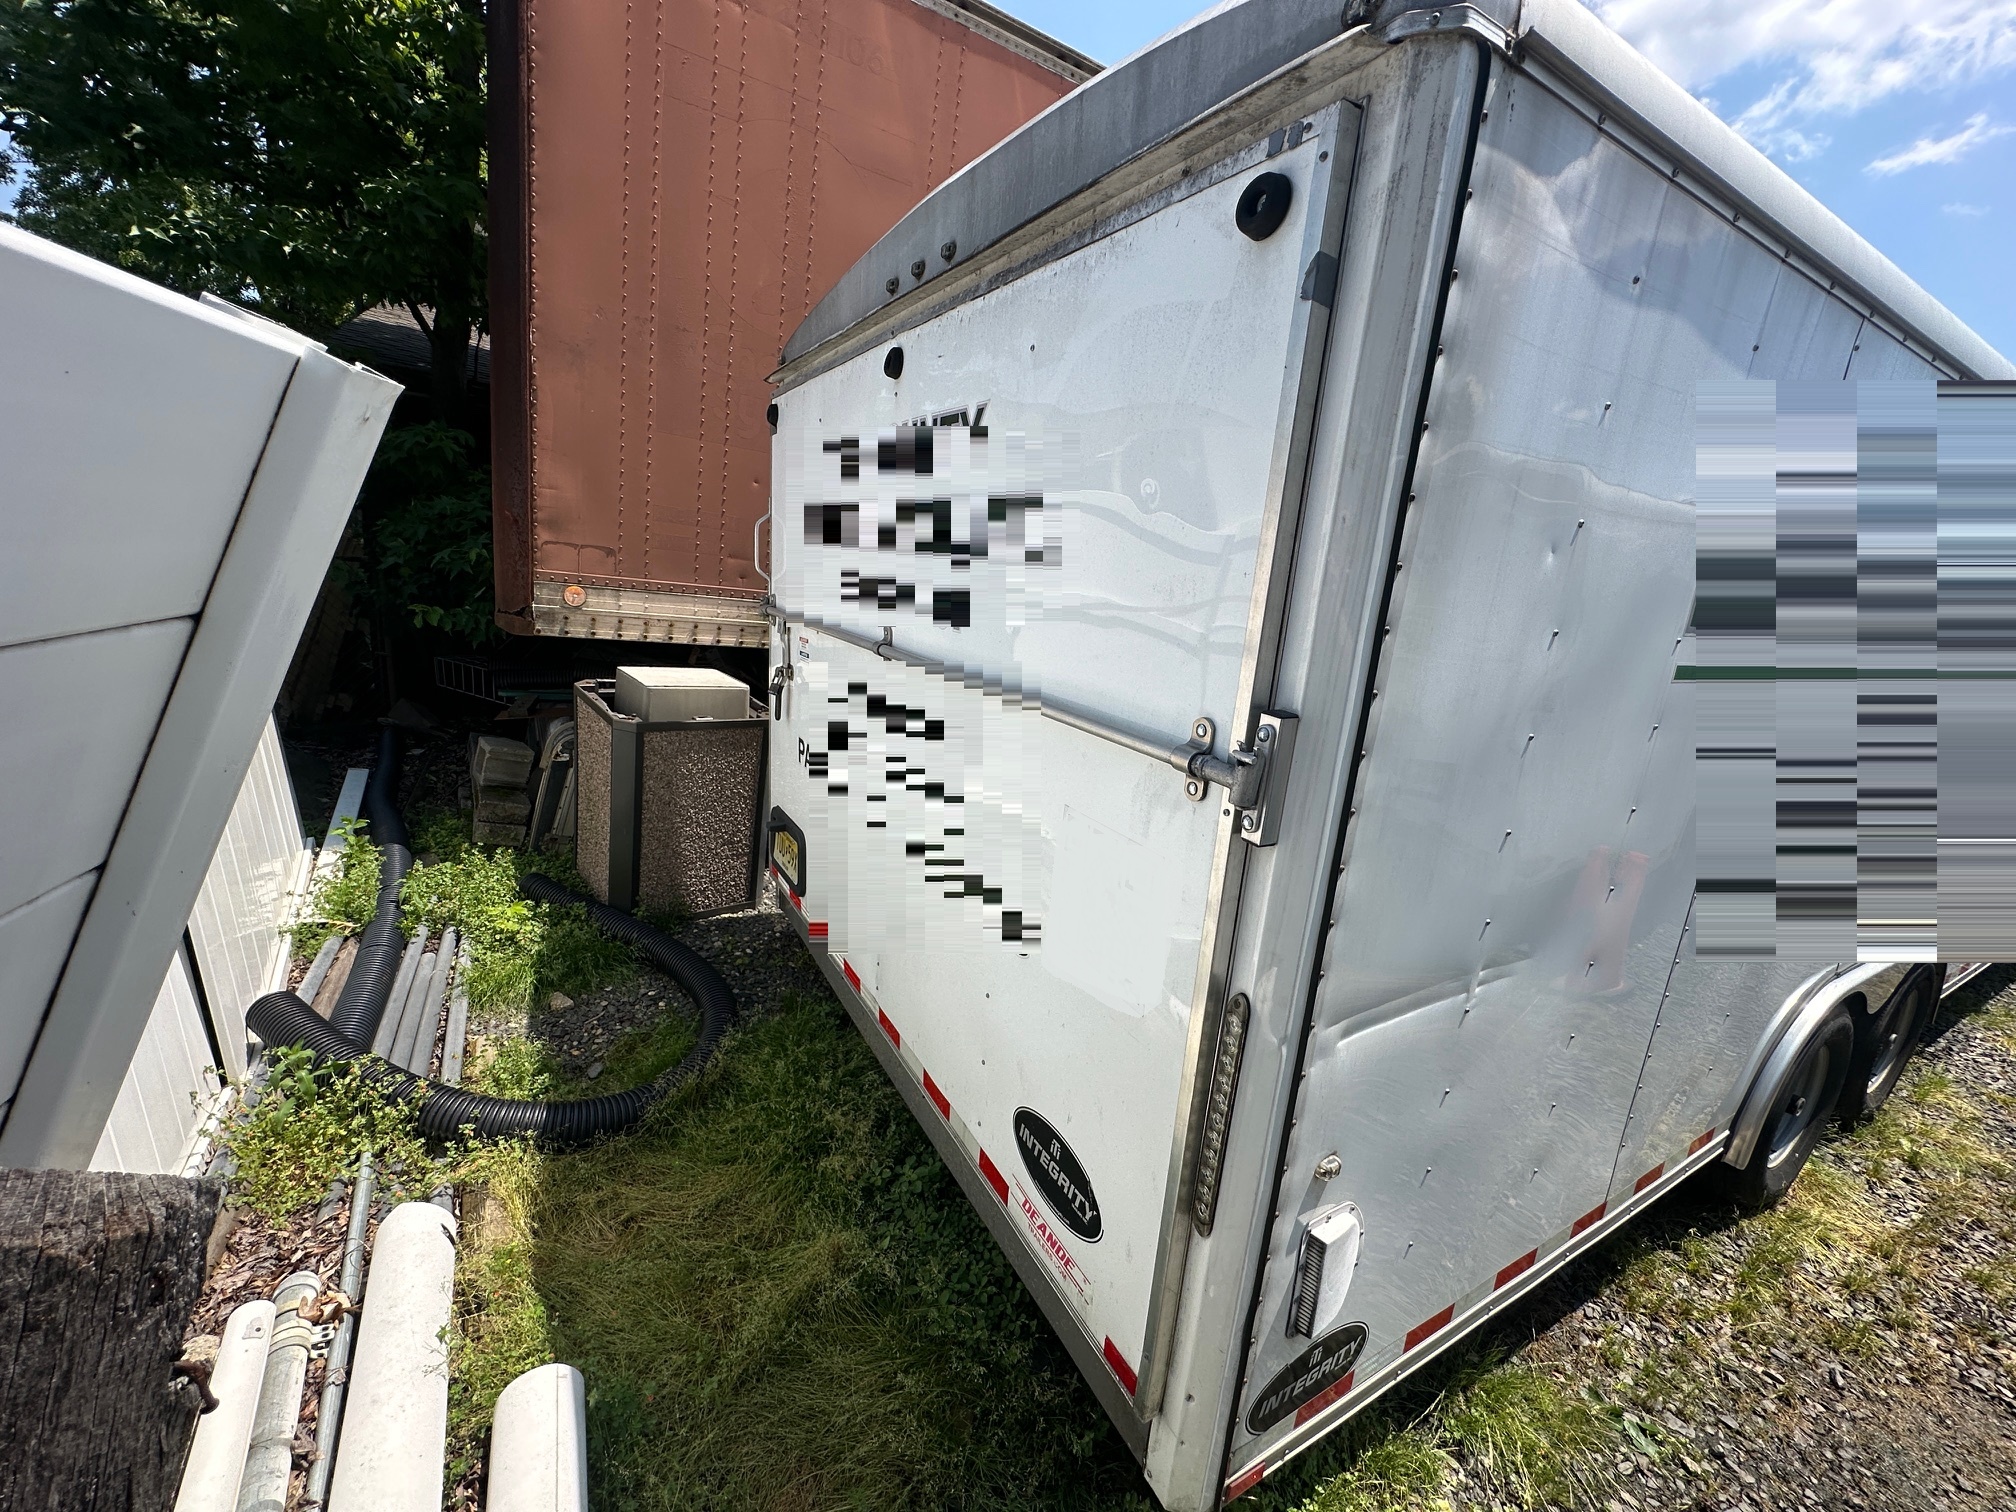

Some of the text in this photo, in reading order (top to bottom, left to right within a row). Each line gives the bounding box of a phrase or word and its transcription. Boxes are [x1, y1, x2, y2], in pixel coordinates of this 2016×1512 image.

[1019, 1123, 1097, 1221] INTEGRITY
[1021, 1197, 1075, 1271] DEANDE
[1258, 1335, 1363, 1419] INTEGRITY
